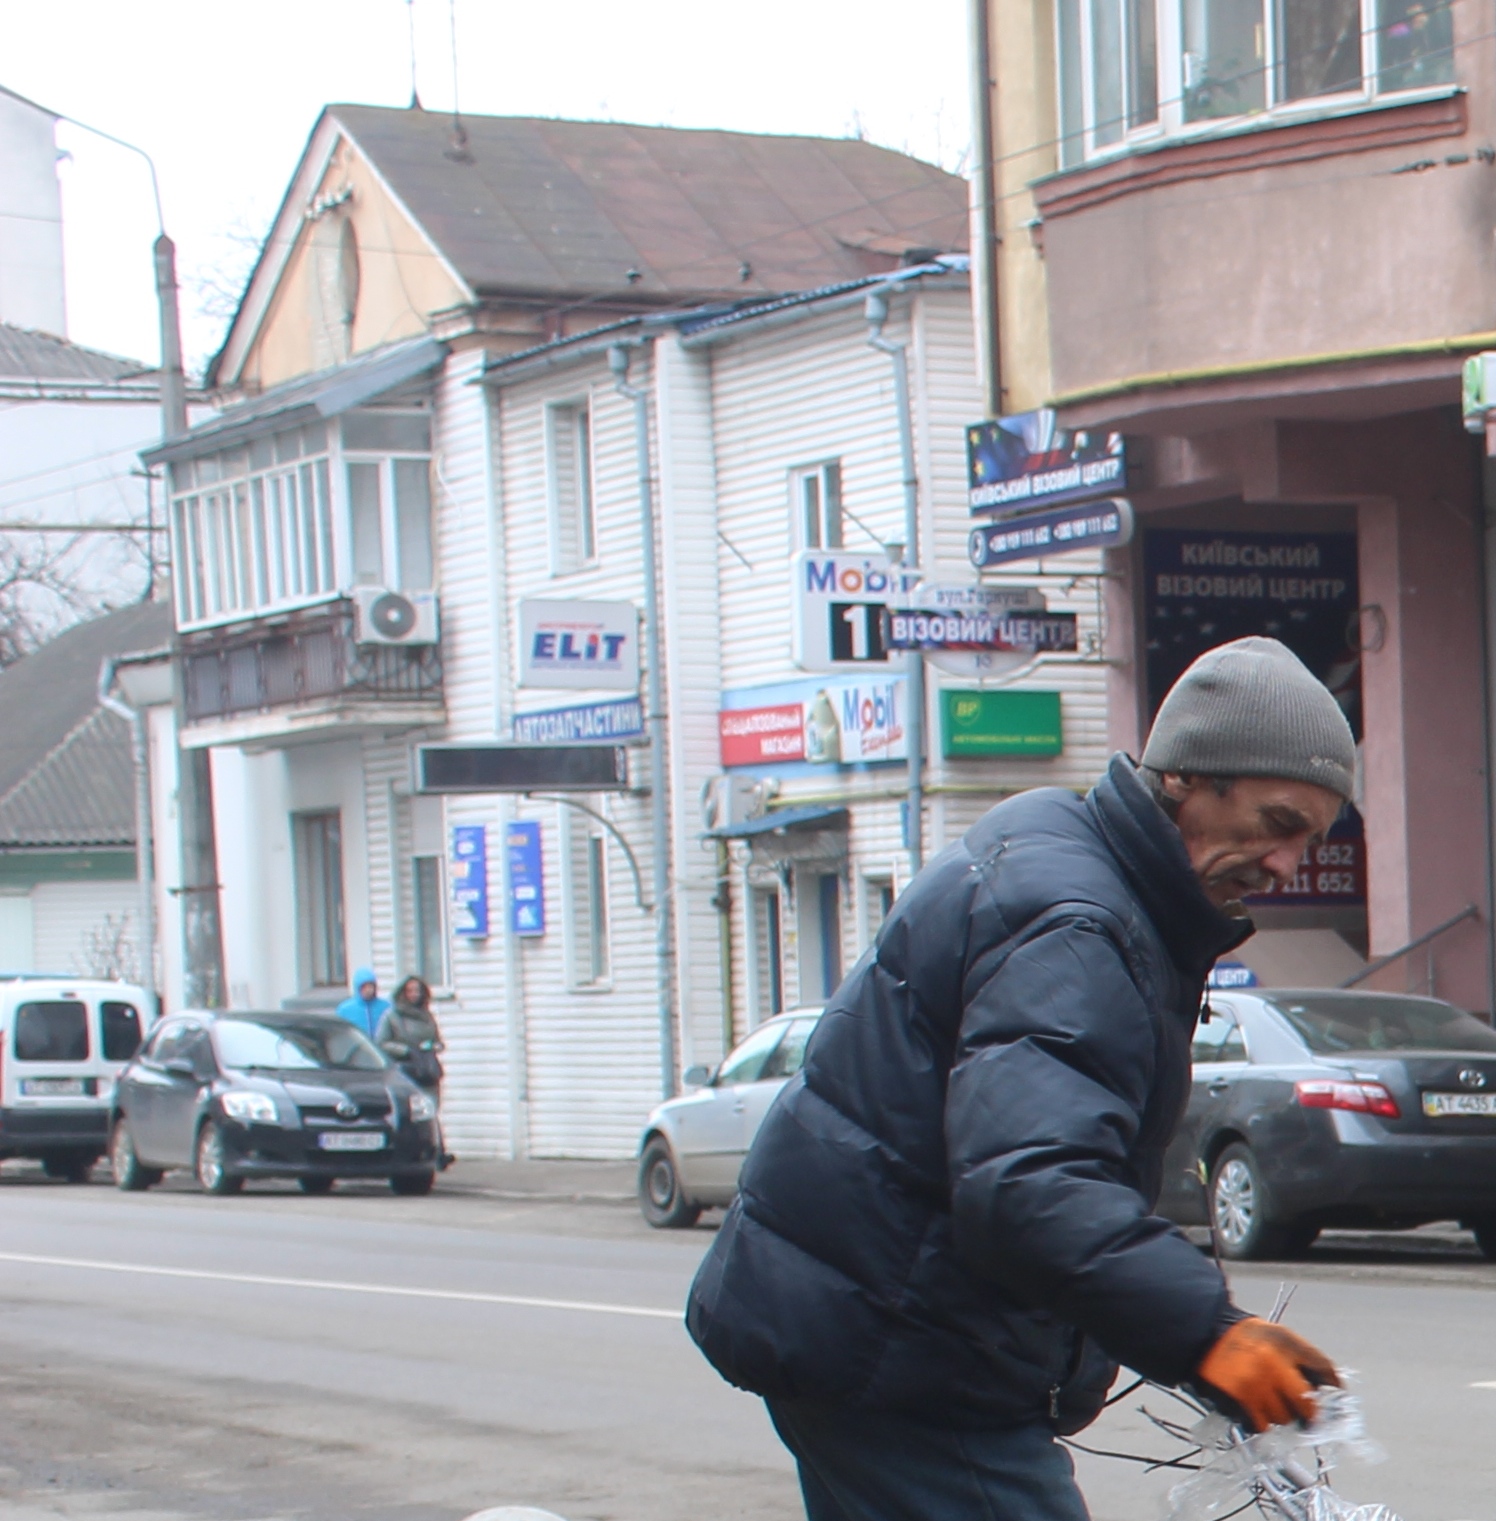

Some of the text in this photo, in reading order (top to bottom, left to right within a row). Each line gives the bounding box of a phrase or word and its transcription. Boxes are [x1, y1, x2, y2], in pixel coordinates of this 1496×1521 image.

[1181, 540, 1321, 568] КИЇВСЬКИЙ
[806, 560, 908, 593] Mobl
[1157, 573, 1347, 603] ВІЗОВИЙ ЦЕНТР
[842, 604, 868, 660] 1
[1000, 617, 1076, 645] ЦЕНТР
[842, 680, 897, 732] Mobil
[1316, 845, 1354, 866] 652
[1317, 871, 1355, 893] 652
